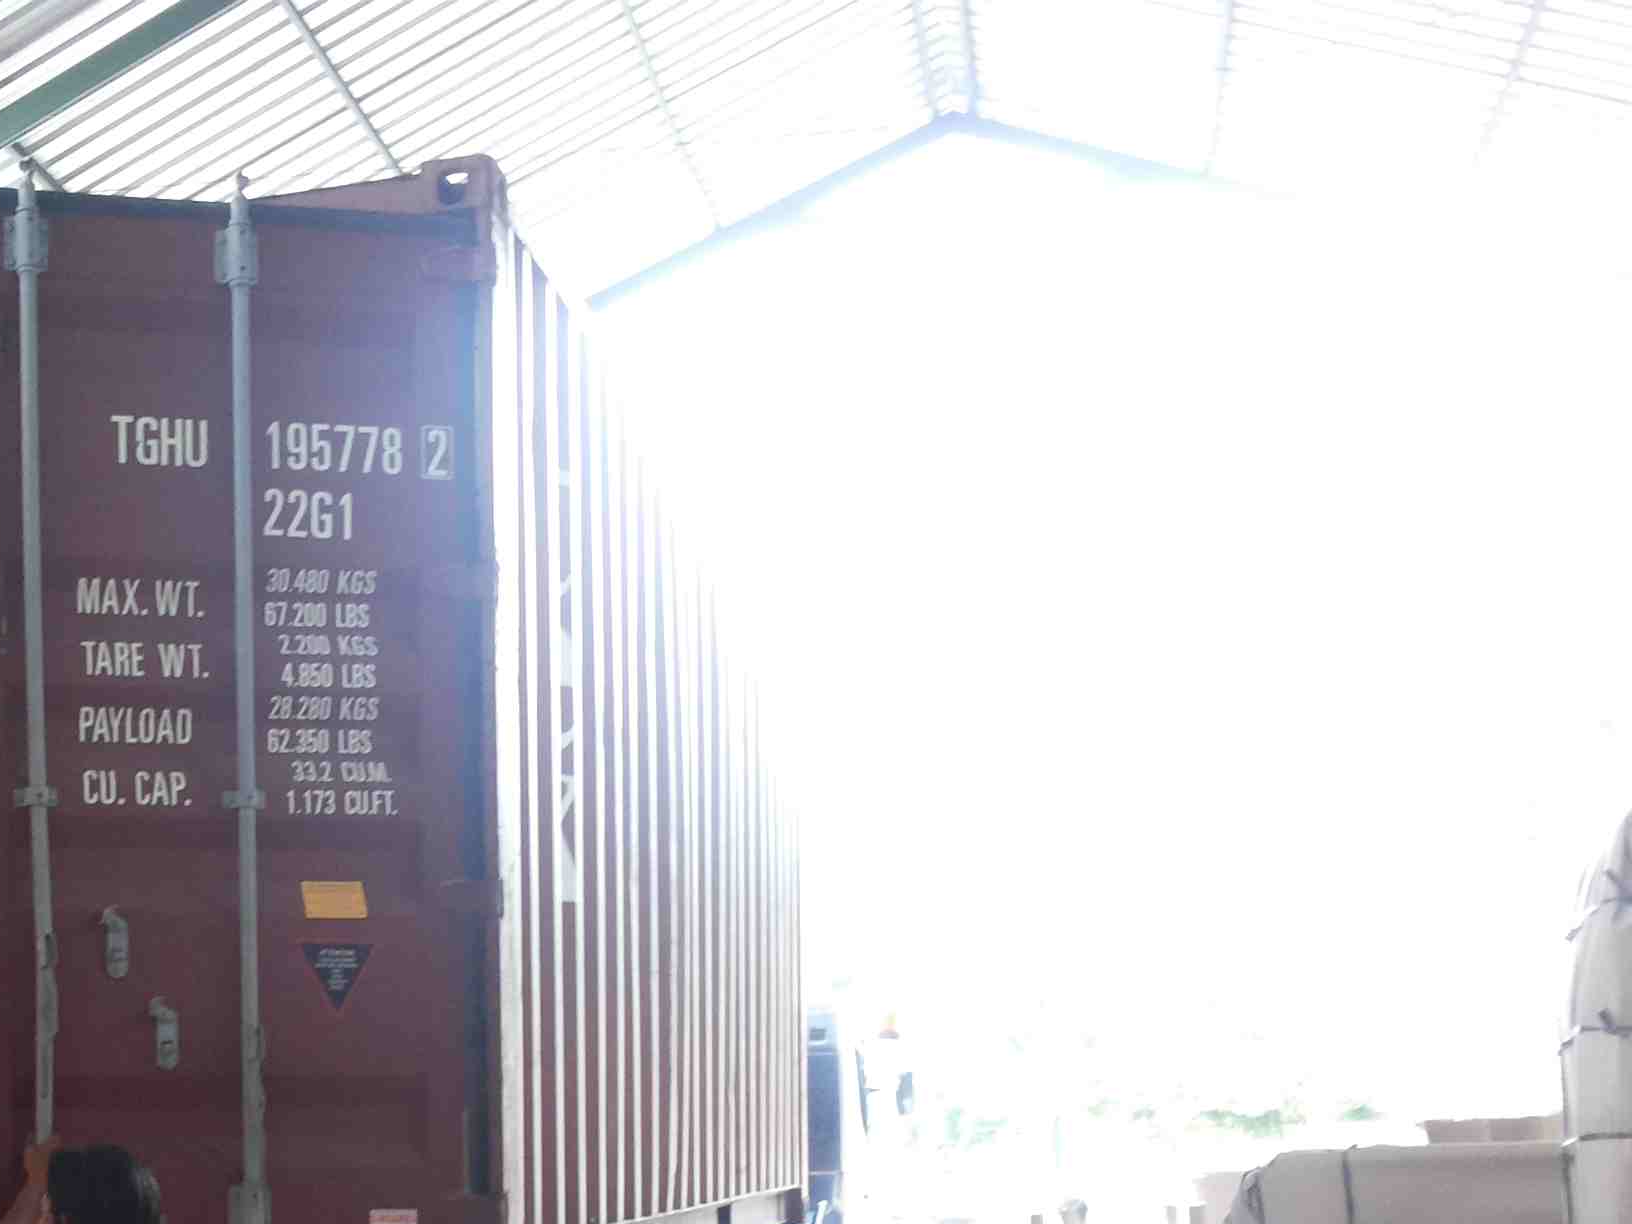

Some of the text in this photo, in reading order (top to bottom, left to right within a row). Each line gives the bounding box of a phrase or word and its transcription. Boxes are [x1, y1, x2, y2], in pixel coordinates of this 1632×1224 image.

[110, 414, 449, 477] TGHU 195778 2
[263, 488, 353, 541] 22G1
[266, 568, 378, 595] 30.480 KGS
[77, 577, 206, 618] MAX. WT.
[264, 601, 370, 628] 67.200 LBS
[80, 640, 210, 679] TARE WT.
[337, 634, 379, 657] KGS
[280, 661, 377, 689] 4.850 LBS
[268, 695, 381, 721] 28.280 KGS
[79, 706, 193, 745] PAYLOAD
[267, 727, 373, 755] 62.350 LBS
[82, 769, 193, 807] CU. CAP.
[285, 789, 337, 816] 1.173
